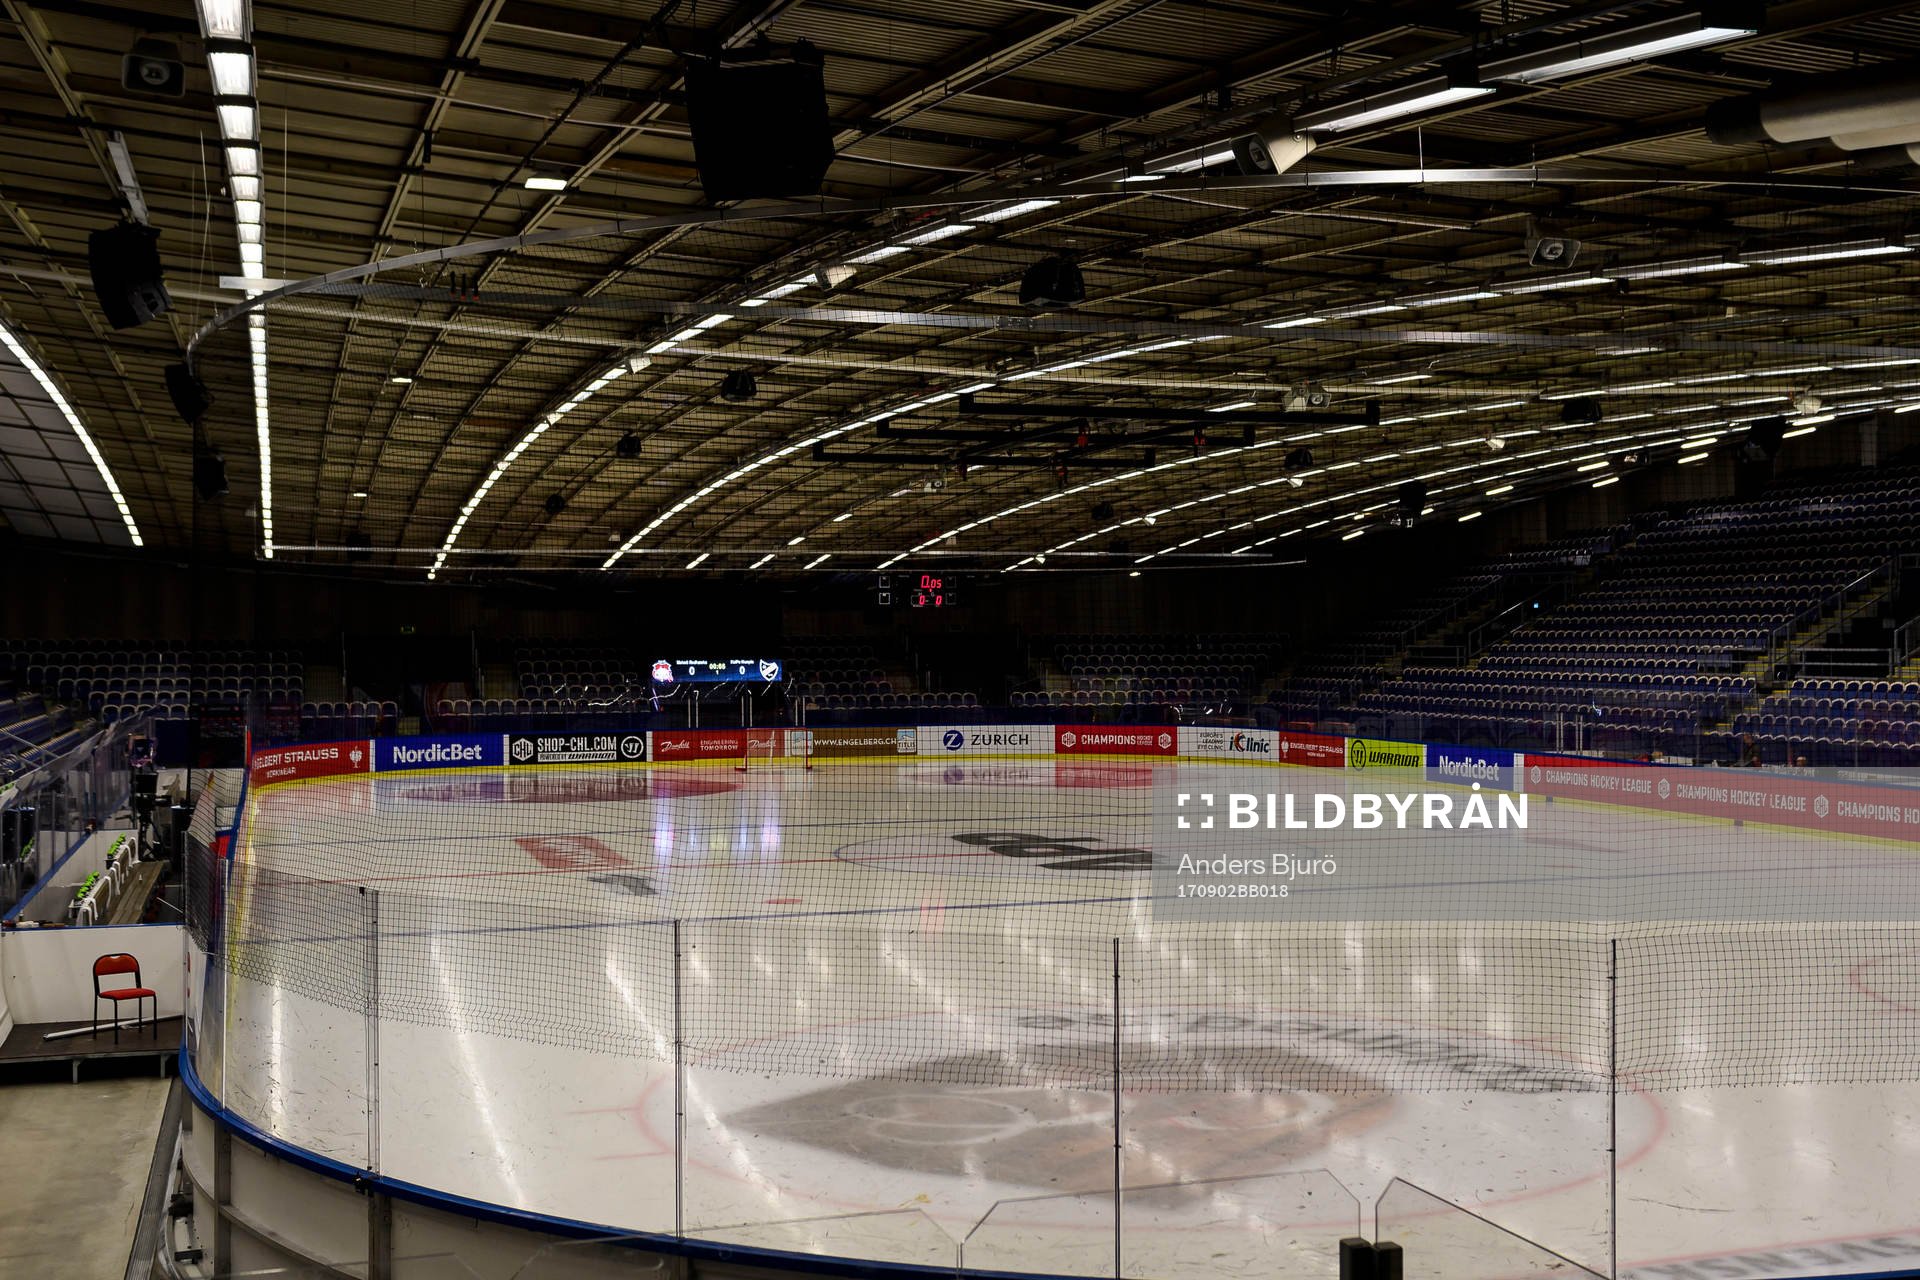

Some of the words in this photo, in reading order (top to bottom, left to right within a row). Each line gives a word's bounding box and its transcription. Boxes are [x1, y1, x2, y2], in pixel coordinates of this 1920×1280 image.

[689, 666, 695, 676] 0
[739, 666, 745, 675] 0
[538, 736, 617, 752] SHOP-CHL.COM
[814, 738, 897, 746] WWW.ENGELBERG.CH
[971, 734, 1029, 746] ZURICH
[1081, 735, 1136, 746] CHAMPIONS
[1229, 732, 1270, 753] iClinic
[284, 747, 339, 763] STRAUSS
[393, 743, 482, 764] NordicBet
[1319, 744, 1344, 754] STRAUSS
[1368, 751, 1420, 768] WARRIOR
[1439, 755, 1500, 782] NordicBet
[1545, 769, 1588, 787] CHAMPIONS
[1590, 774, 1620, 791] HOCKEY
[1621, 777, 1652, 794] LEAGUE
[1676, 783, 1728, 803] CHAMPIONS
[1730, 789, 1767, 807] HOCKEY
[1769, 794, 1807, 812] LEAGUE
[1837, 800, 1901, 823] CHAMPIONS
